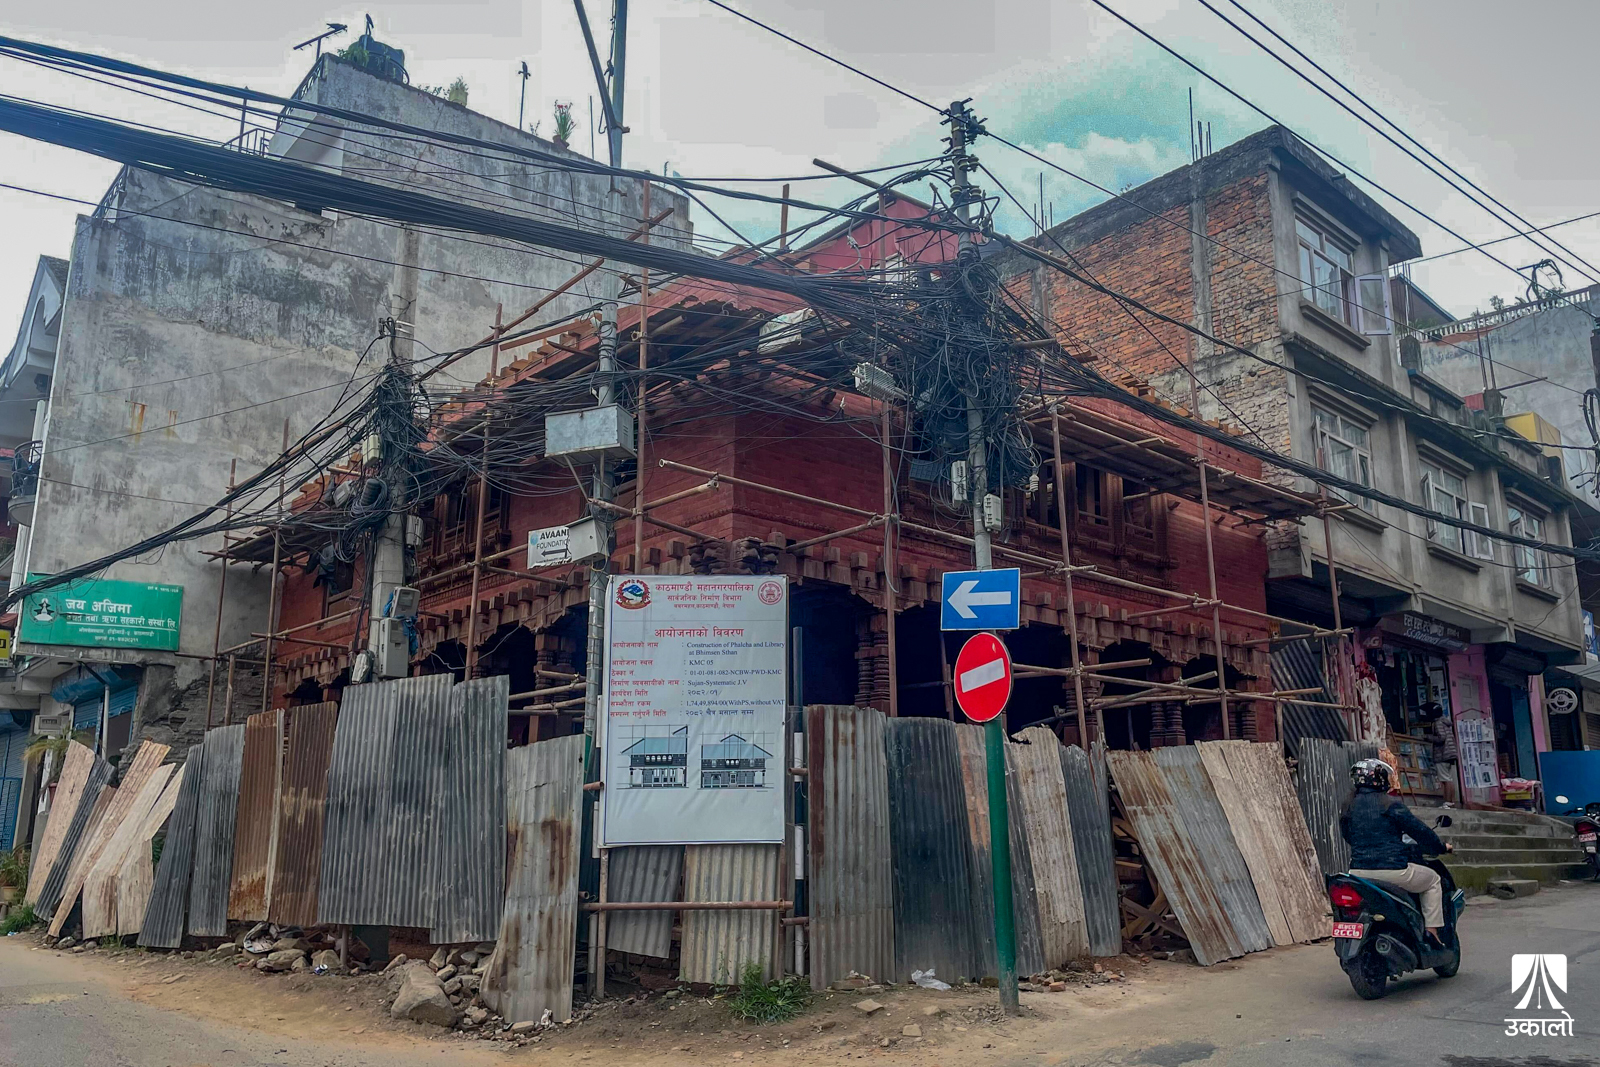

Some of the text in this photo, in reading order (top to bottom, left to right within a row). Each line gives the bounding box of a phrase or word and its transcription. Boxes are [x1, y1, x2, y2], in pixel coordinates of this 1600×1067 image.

[655, 581, 754, 592] काठमाण्डौ महानगरपालिका
[65, 598, 132, 614] जय अजिमा
[654, 626, 744, 638] आयोजनाको विवरण
[634, 689, 649, 697] मिति
[652, 709, 668, 717] मिति
